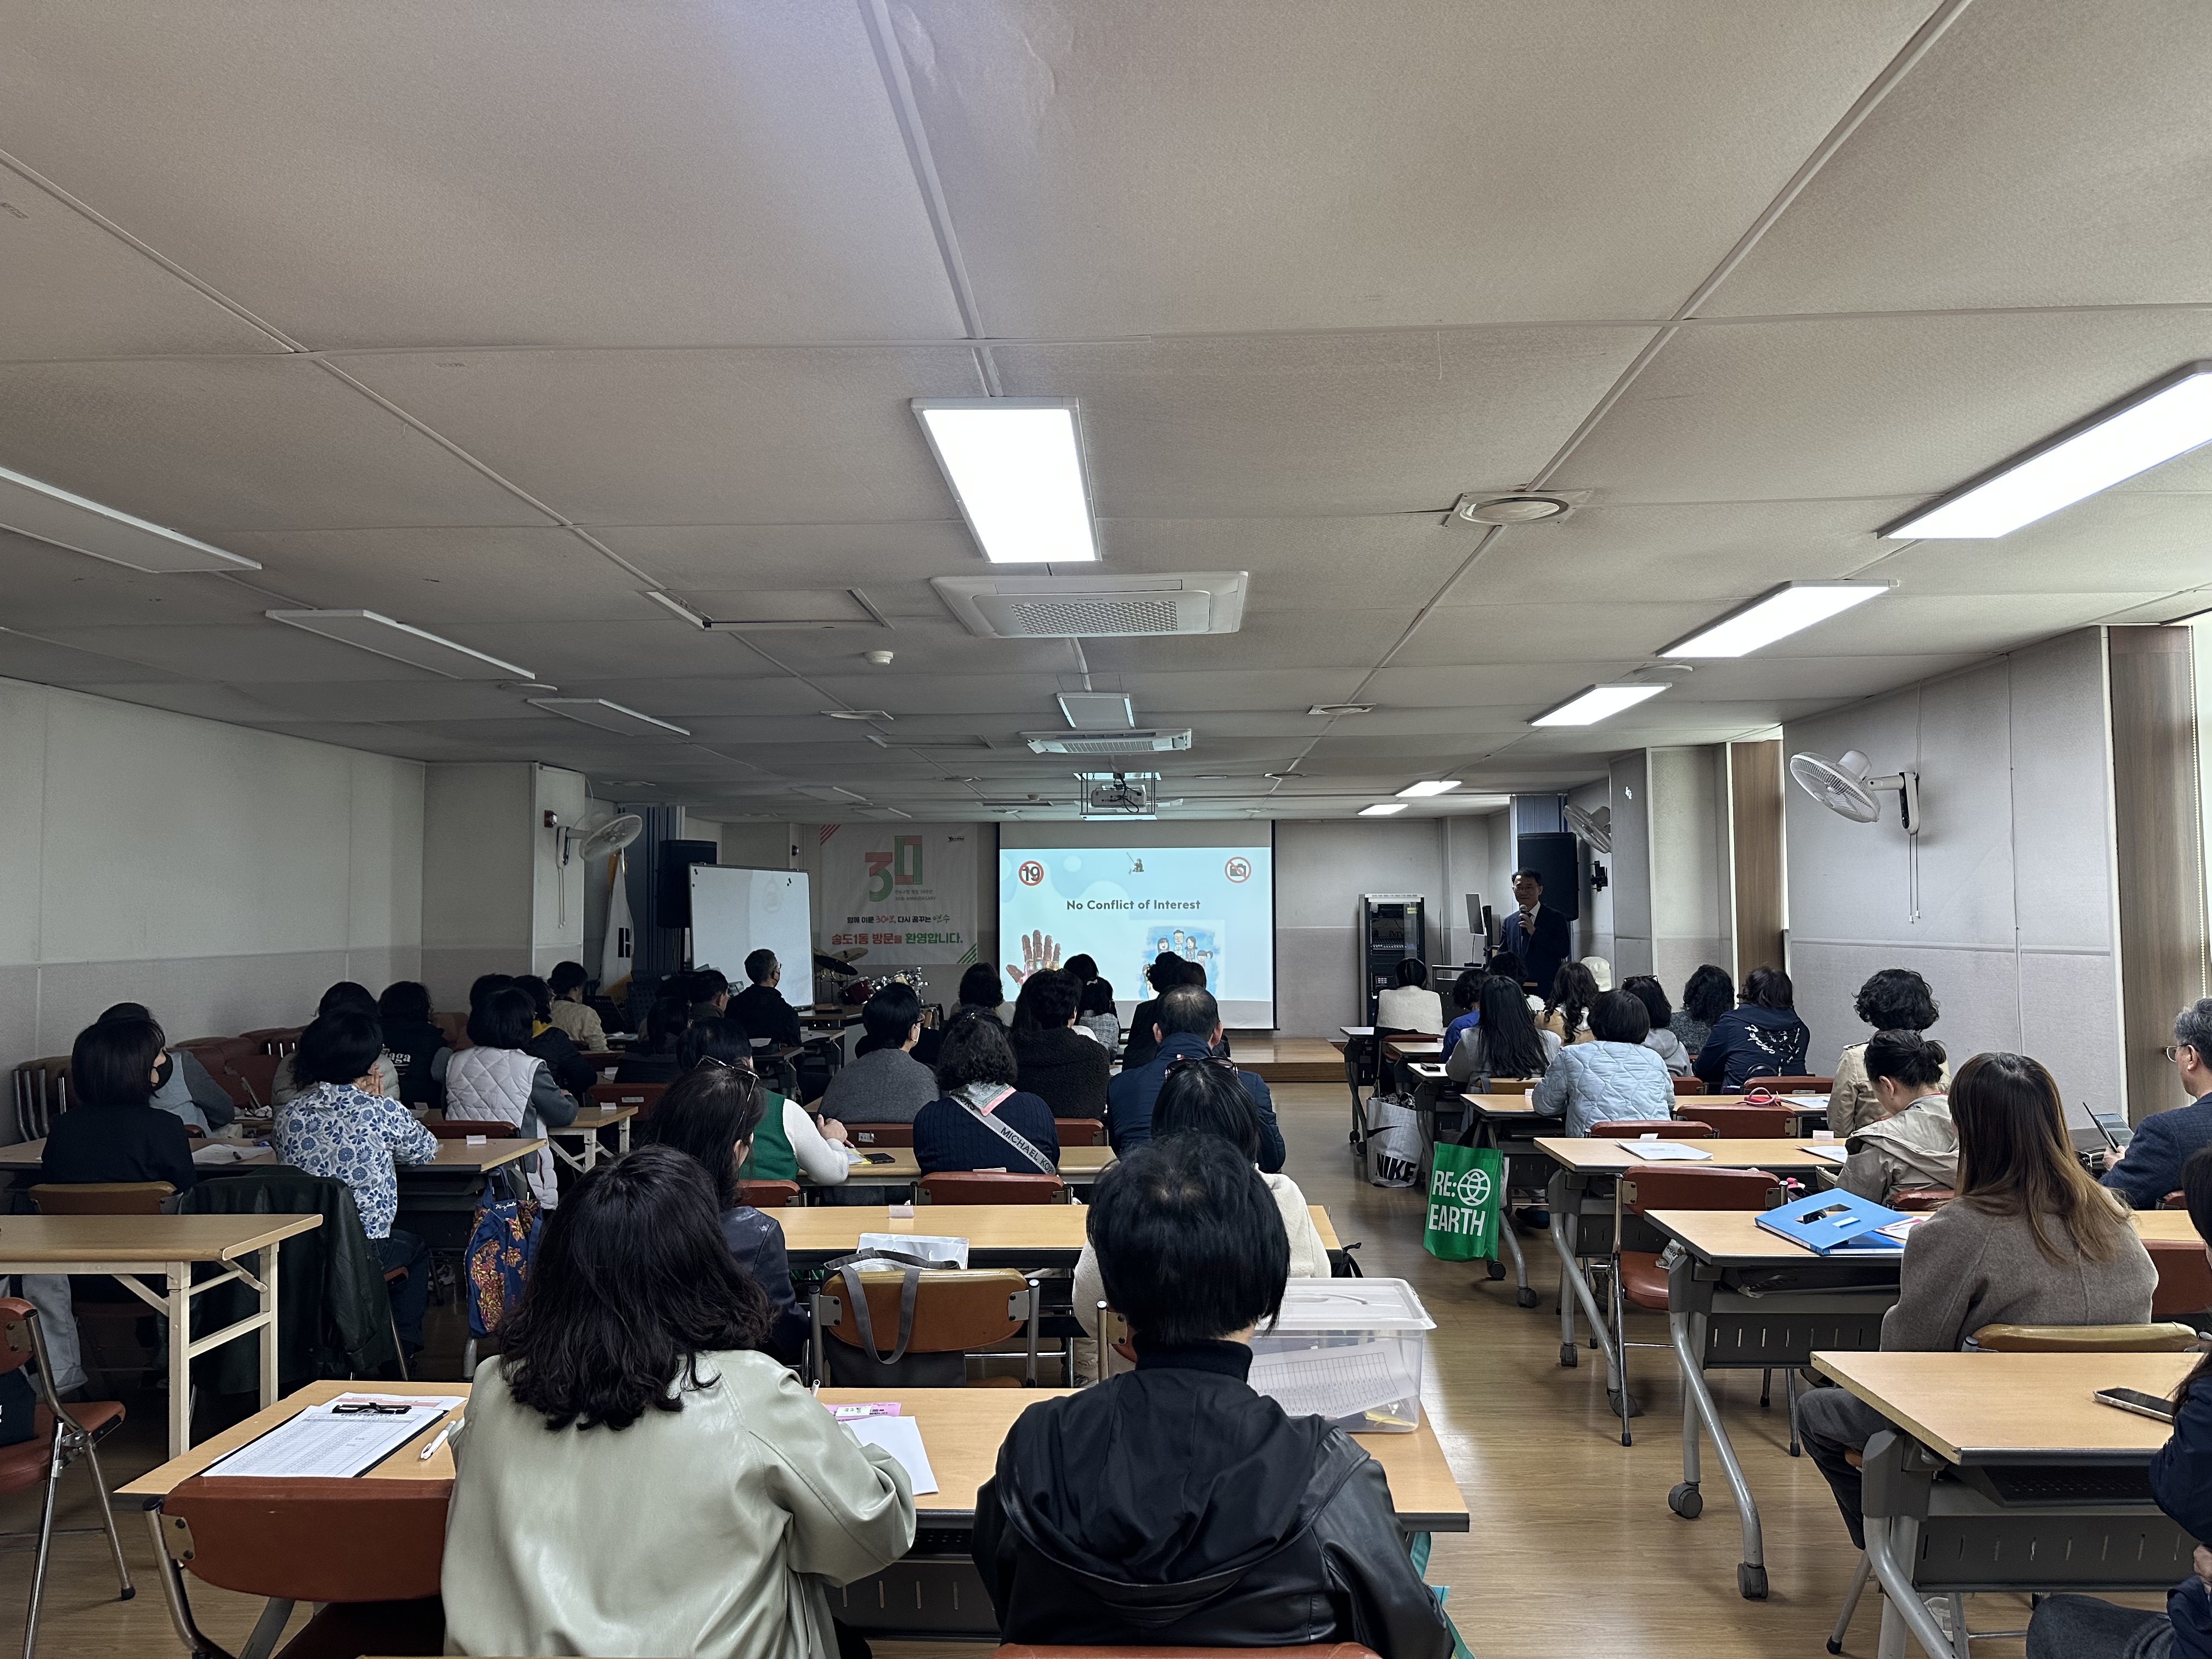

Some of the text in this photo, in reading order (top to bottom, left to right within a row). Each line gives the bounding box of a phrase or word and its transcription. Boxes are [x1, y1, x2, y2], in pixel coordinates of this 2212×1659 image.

[865, 836, 922, 901] 30
[1023, 866, 1040, 882] 19
[1067, 900, 1200, 910] No Conflict of Interest
[831, 933, 963, 945] 송도1동 방문을 환영합니다.
[1001, 1127, 1038, 1161] MICHAEL
[1375, 1153, 1417, 1183] NIKE
[1432, 1170, 1457, 1197] RE:
[1428, 1204, 1486, 1237] EARTH
